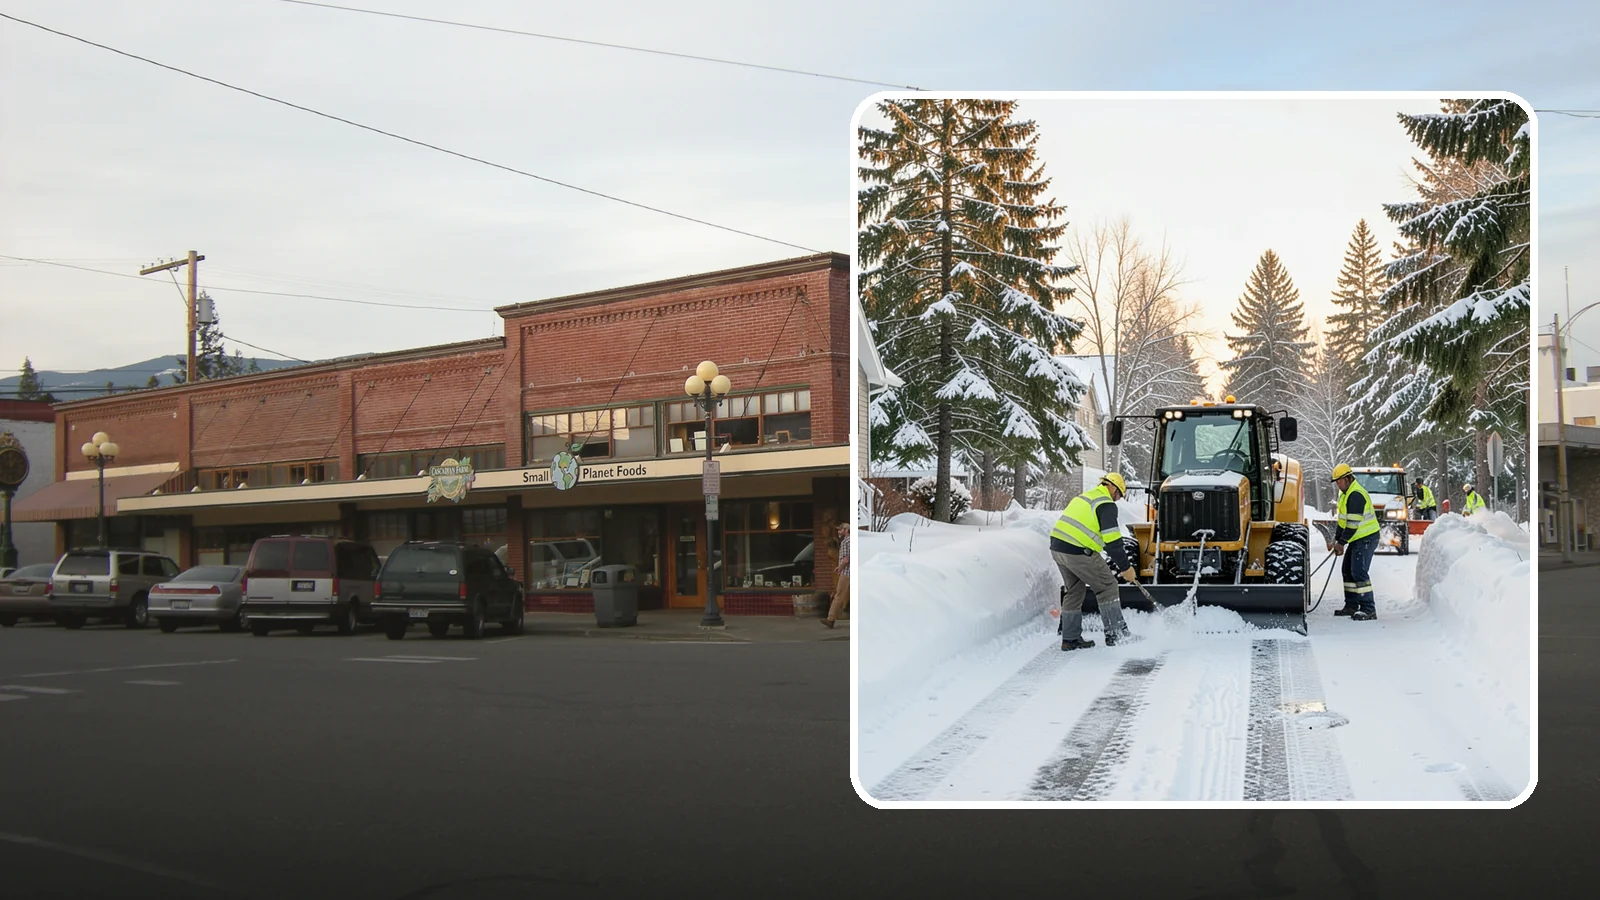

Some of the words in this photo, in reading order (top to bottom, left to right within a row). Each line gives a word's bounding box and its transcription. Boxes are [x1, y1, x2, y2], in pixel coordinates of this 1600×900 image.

[523, 472, 548, 482] Small
[583, 468, 614, 479] Planet
[617, 464, 647, 476] Foods
